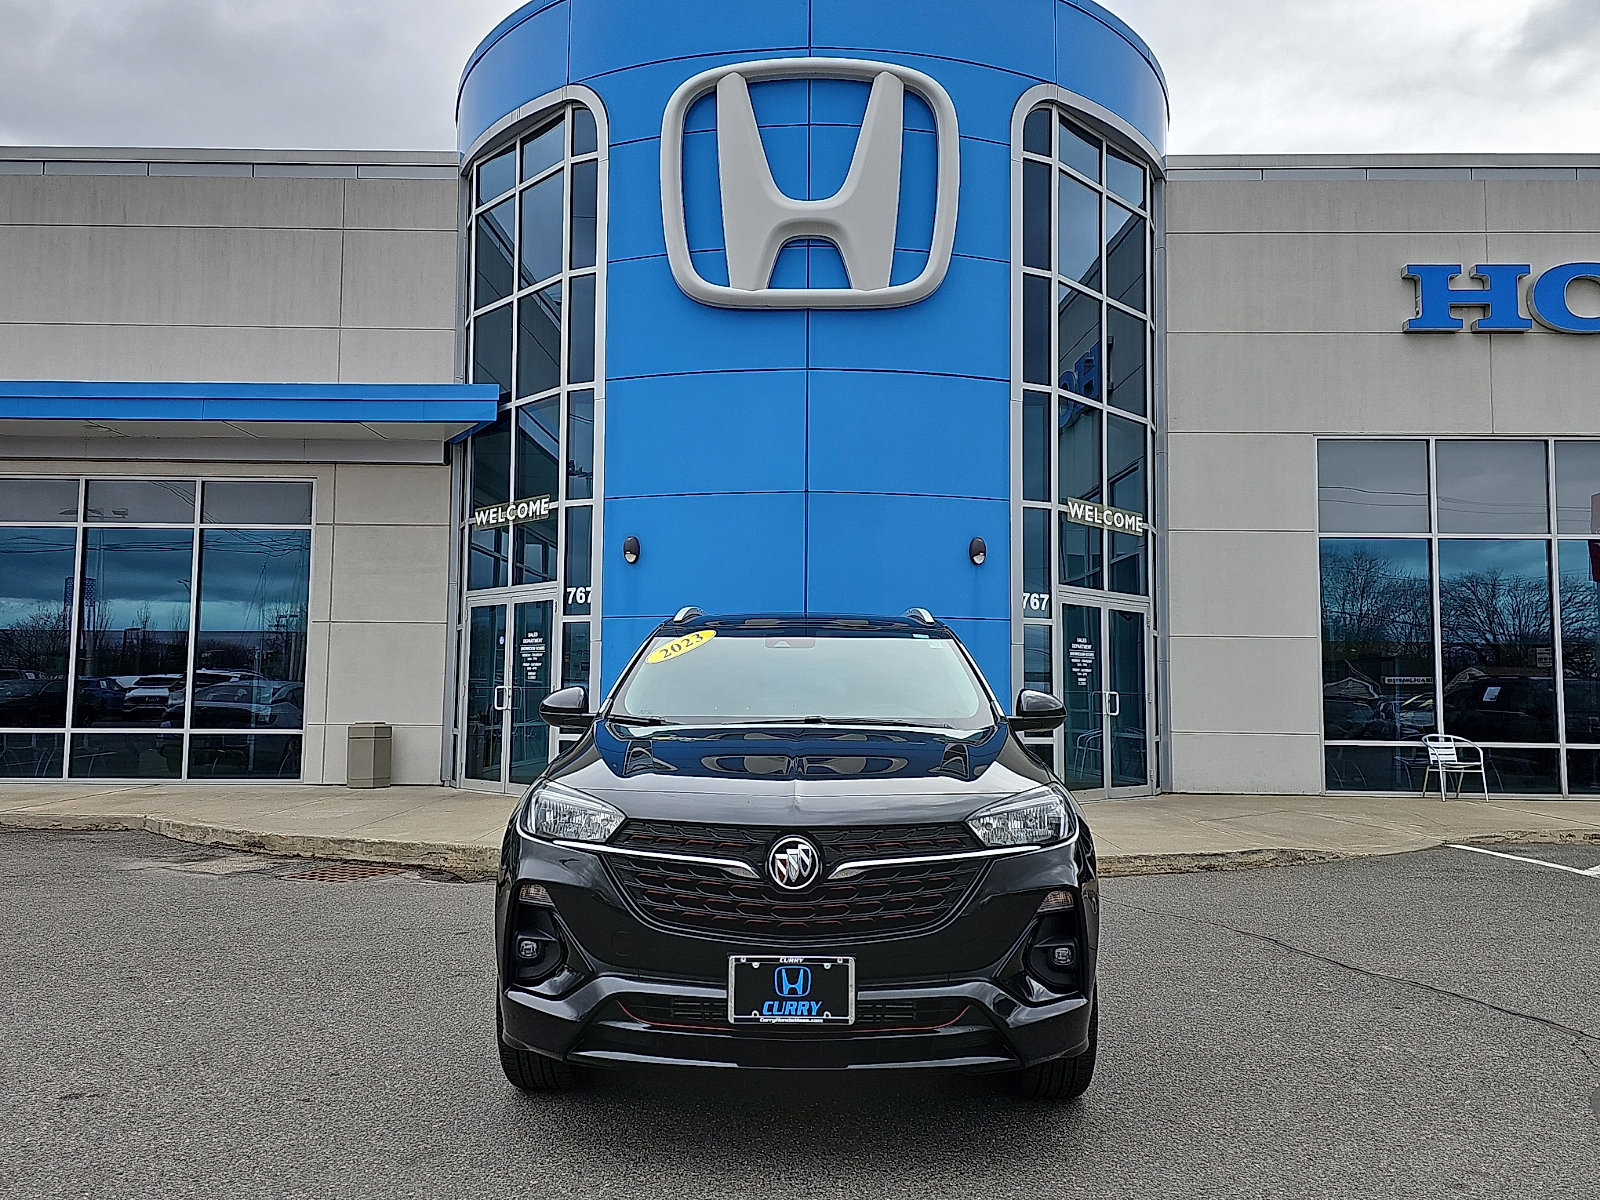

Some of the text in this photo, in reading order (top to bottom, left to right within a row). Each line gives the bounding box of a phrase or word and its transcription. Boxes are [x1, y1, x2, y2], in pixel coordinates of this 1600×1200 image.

[475, 497, 550, 526] WELCOME
[1068, 501, 1143, 533] WELCOME
[566, 587, 592, 605] 767
[1022, 593, 1050, 611] 767
[659, 632, 704, 659] 2023
[762, 1000, 823, 1016] CURRY
